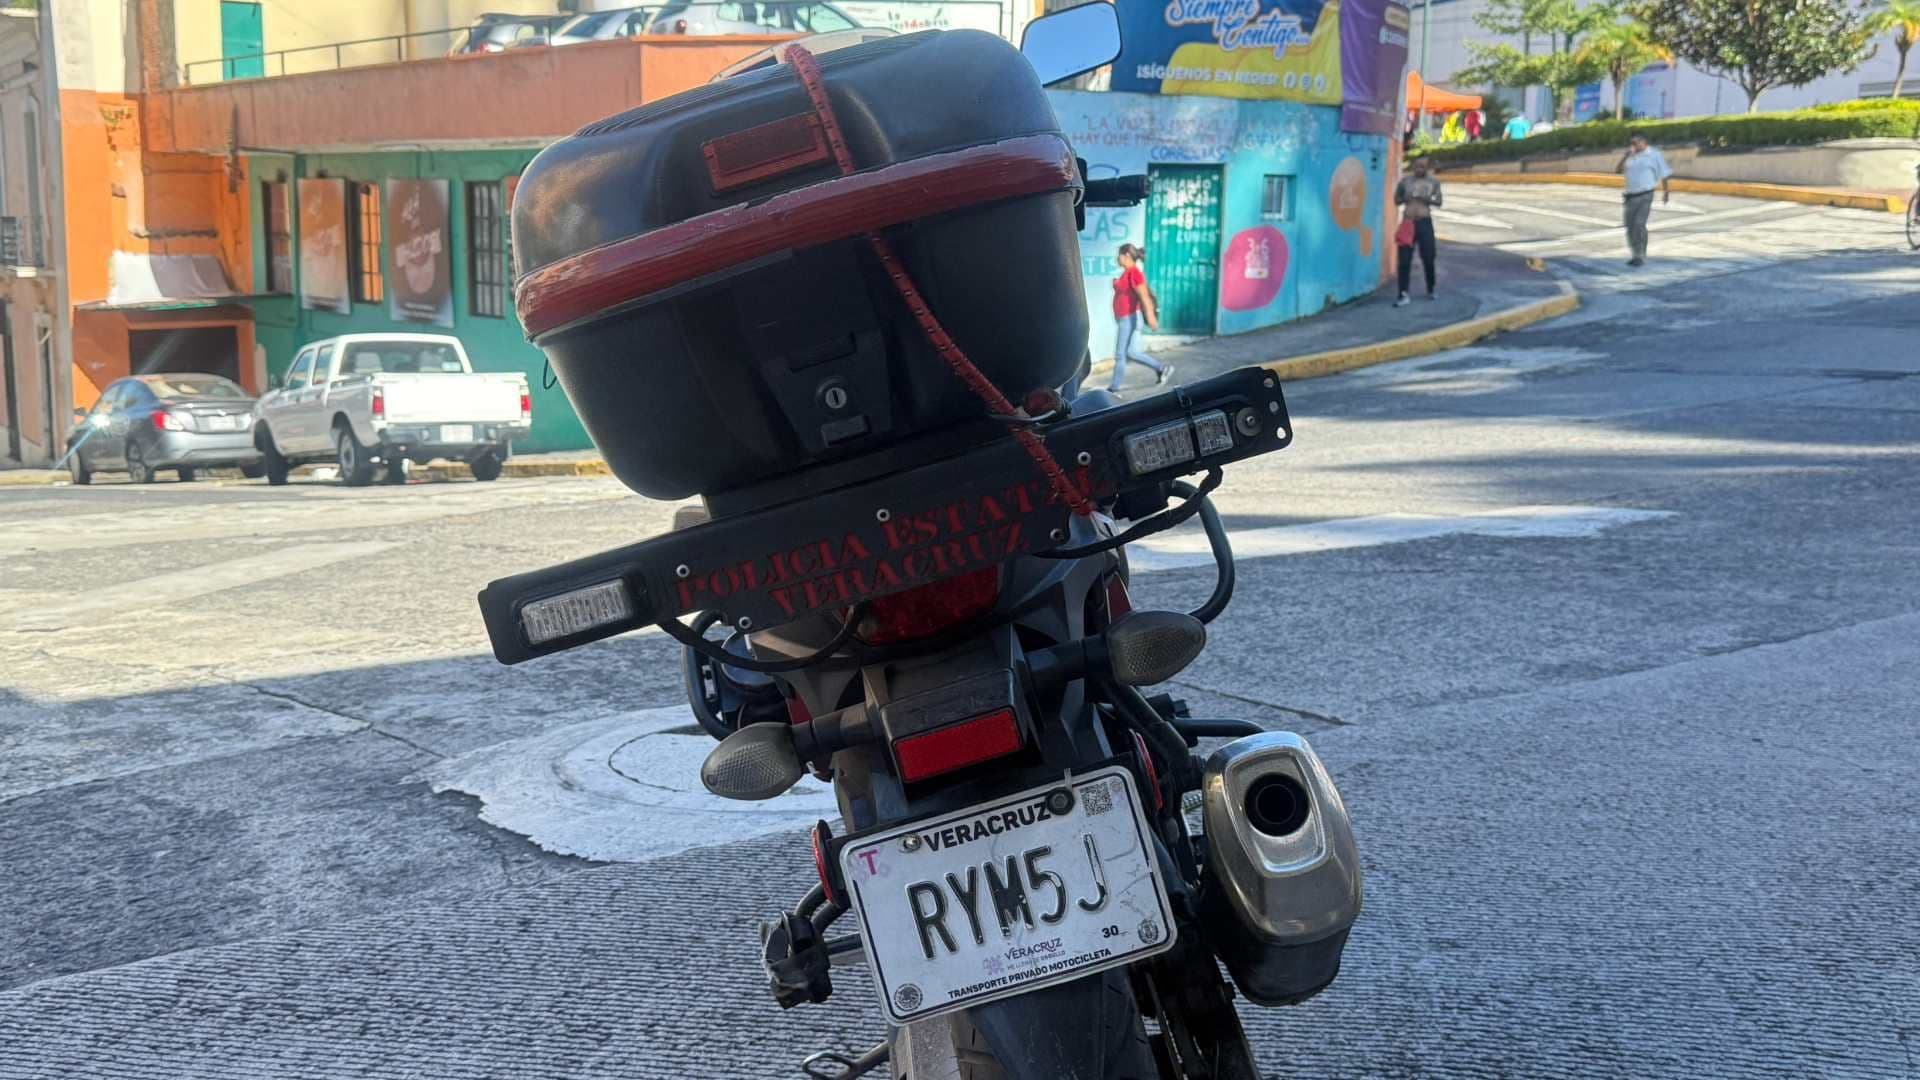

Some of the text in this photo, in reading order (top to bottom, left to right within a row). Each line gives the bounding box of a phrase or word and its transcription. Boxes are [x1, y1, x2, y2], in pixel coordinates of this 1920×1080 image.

[1168, 0, 1258, 32] Siempre
[1215, 70, 1233, 82] EN
[674, 466, 1108, 612] POLICIA ESTATL
[769, 521, 1030, 618] VERACRUZ
[923, 803, 1051, 852] VERACRUZ
[859, 849, 879, 876] T
[904, 833, 1109, 960] RYM5J
[1004, 937, 1063, 960] VERACRUZ
[1102, 925, 1119, 939] 30
[948, 948, 1112, 998] TRANSPORTE PRIVADO MOTOCICLETA
